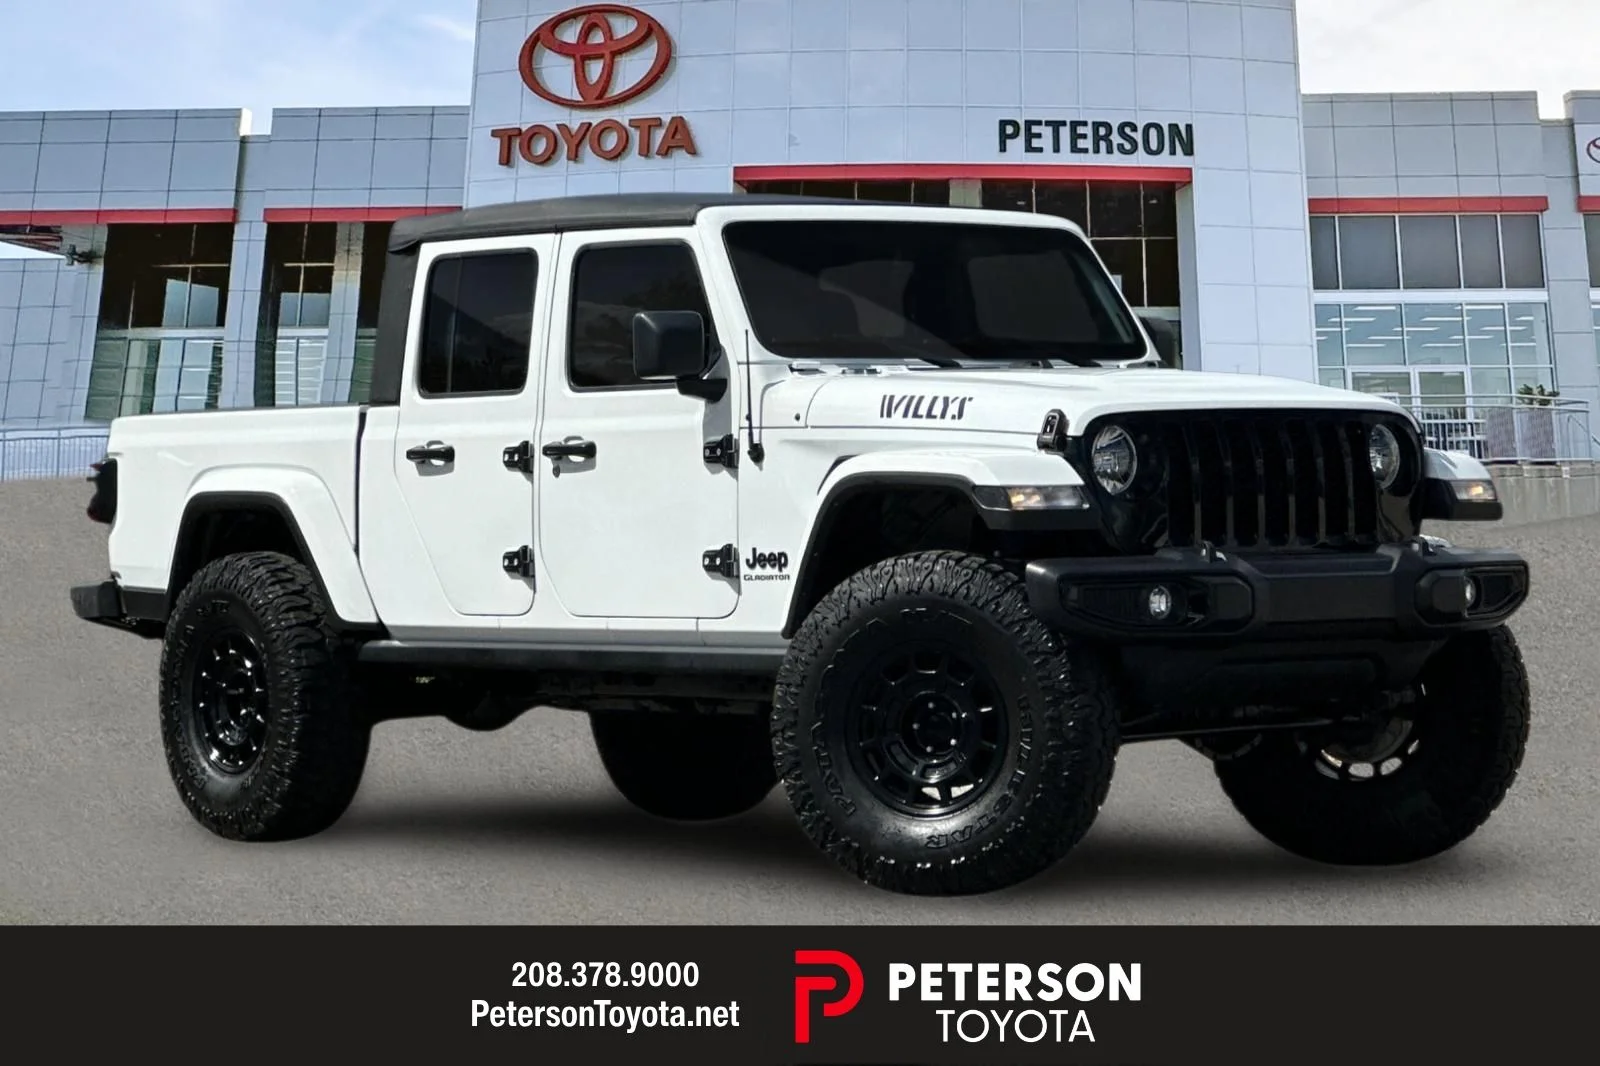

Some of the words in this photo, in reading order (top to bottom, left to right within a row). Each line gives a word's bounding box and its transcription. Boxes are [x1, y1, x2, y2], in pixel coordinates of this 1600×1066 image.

[491, 116, 697, 166] TOYOTA
[998, 119, 1194, 156] PETERSON
[880, 394, 974, 420] WILLYS
[745, 547, 789, 572] Jeep
